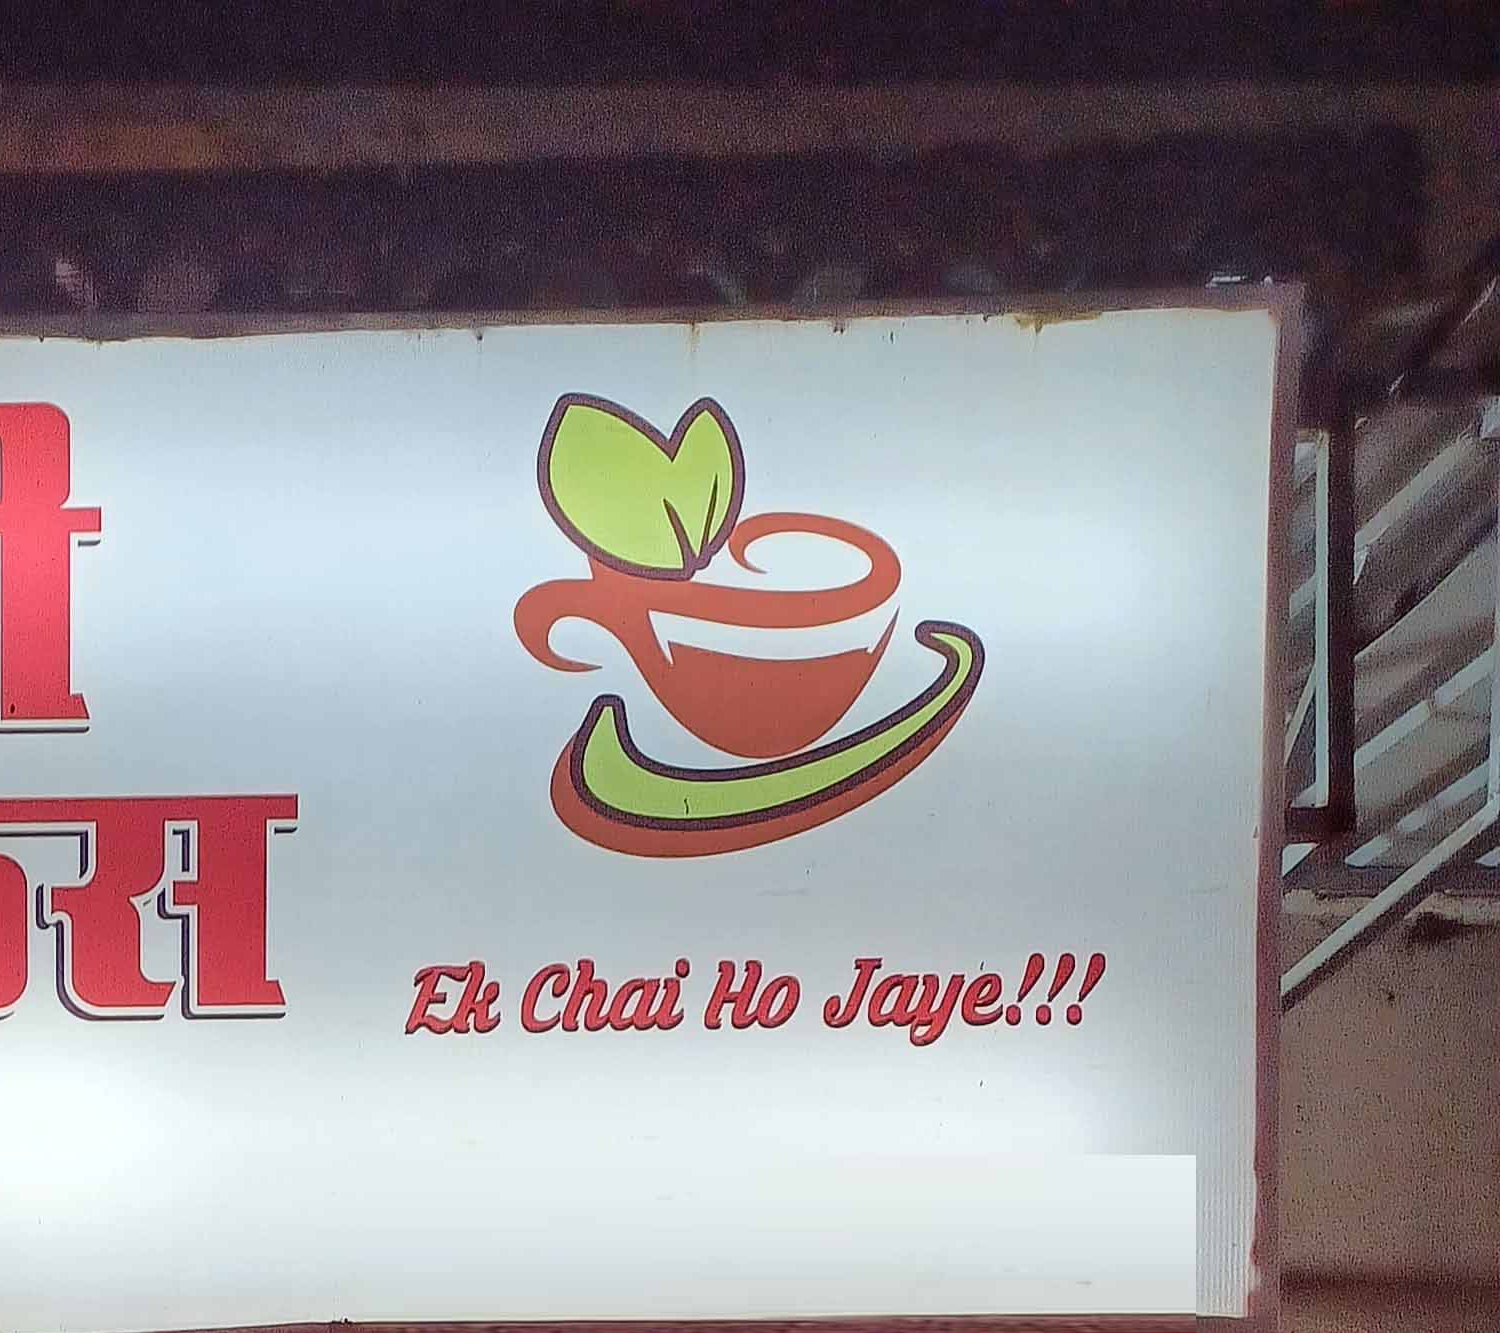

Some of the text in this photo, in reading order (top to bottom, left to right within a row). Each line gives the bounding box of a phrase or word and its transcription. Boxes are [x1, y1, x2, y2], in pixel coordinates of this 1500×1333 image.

[404, 952, 1107, 1047] Ek Chai Ho Jaye!!!
